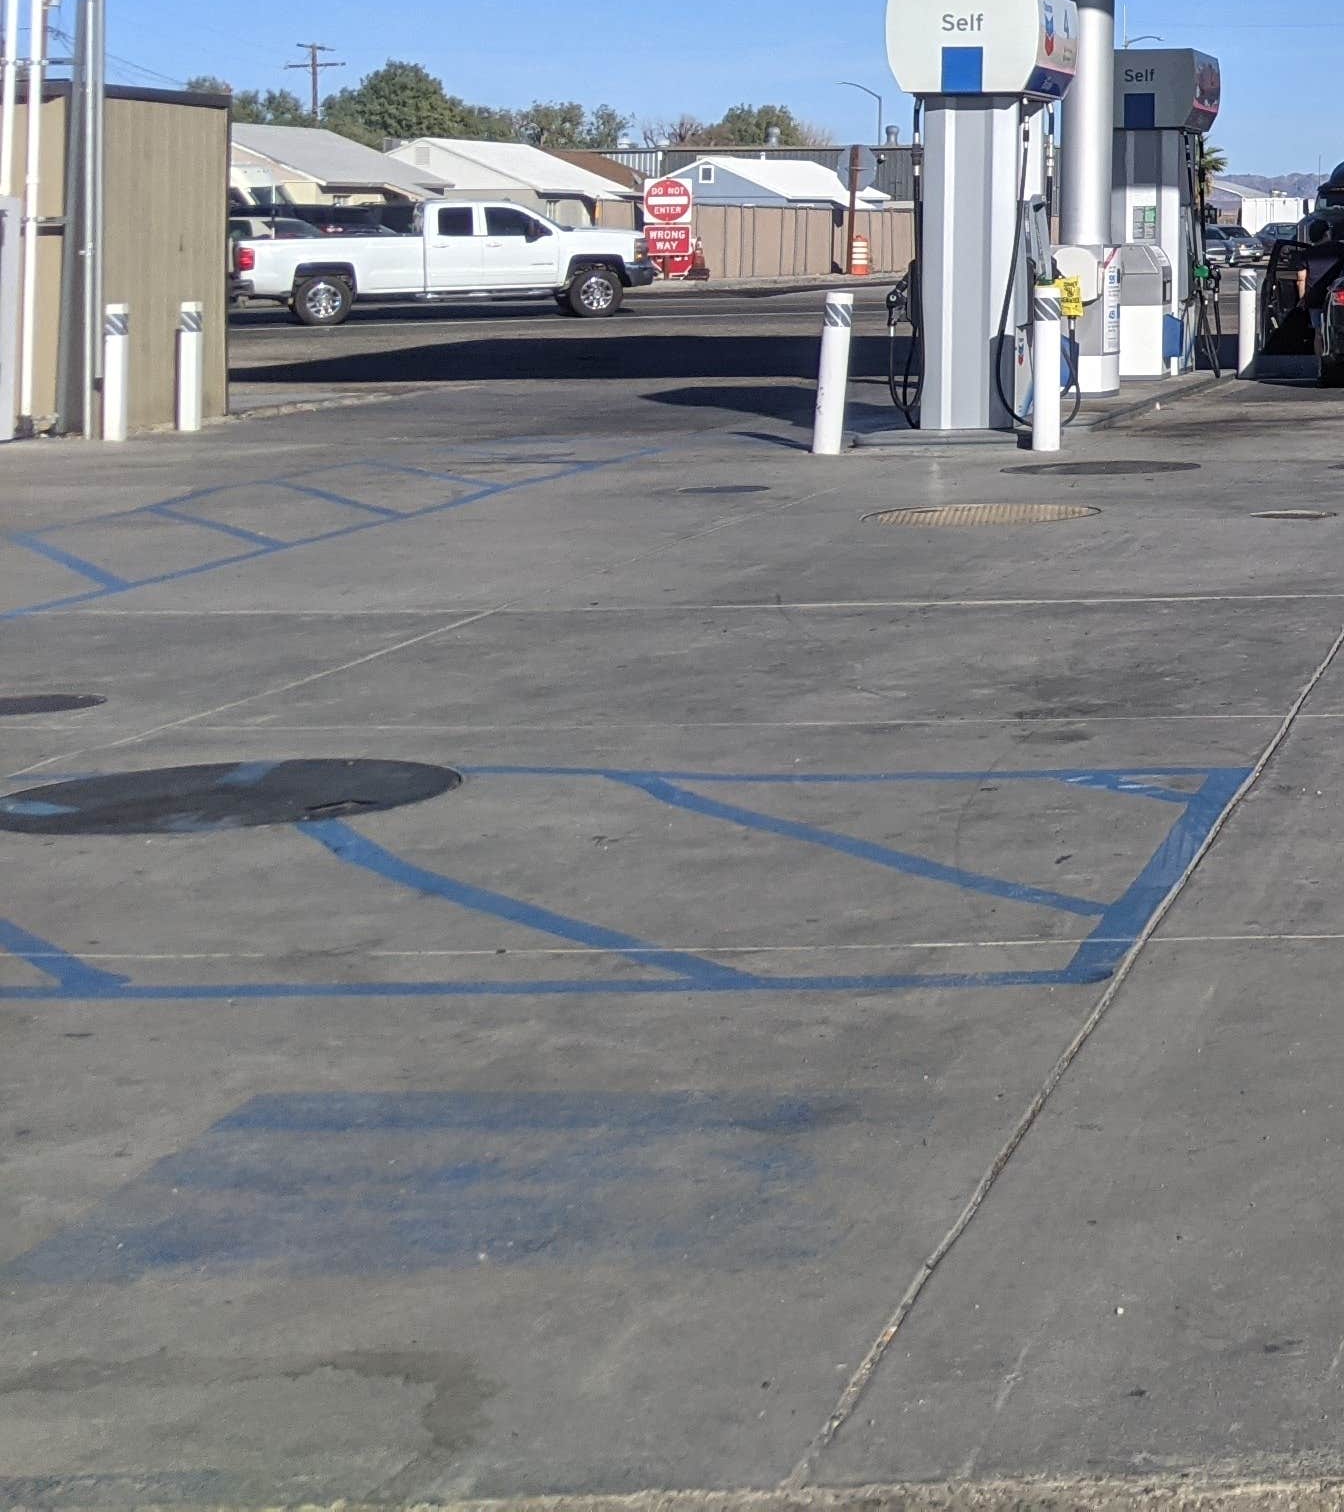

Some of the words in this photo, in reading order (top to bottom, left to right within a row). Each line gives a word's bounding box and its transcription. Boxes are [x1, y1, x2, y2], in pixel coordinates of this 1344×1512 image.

[941, 12, 984, 32] Self
[1123, 68, 1155, 82] Self
[651, 187, 664, 195] DO
[667, 187, 685, 195] NOT
[654, 206, 682, 215] ENTER
[649, 230, 686, 240] WRONG
[655, 241, 679, 250] WAY
